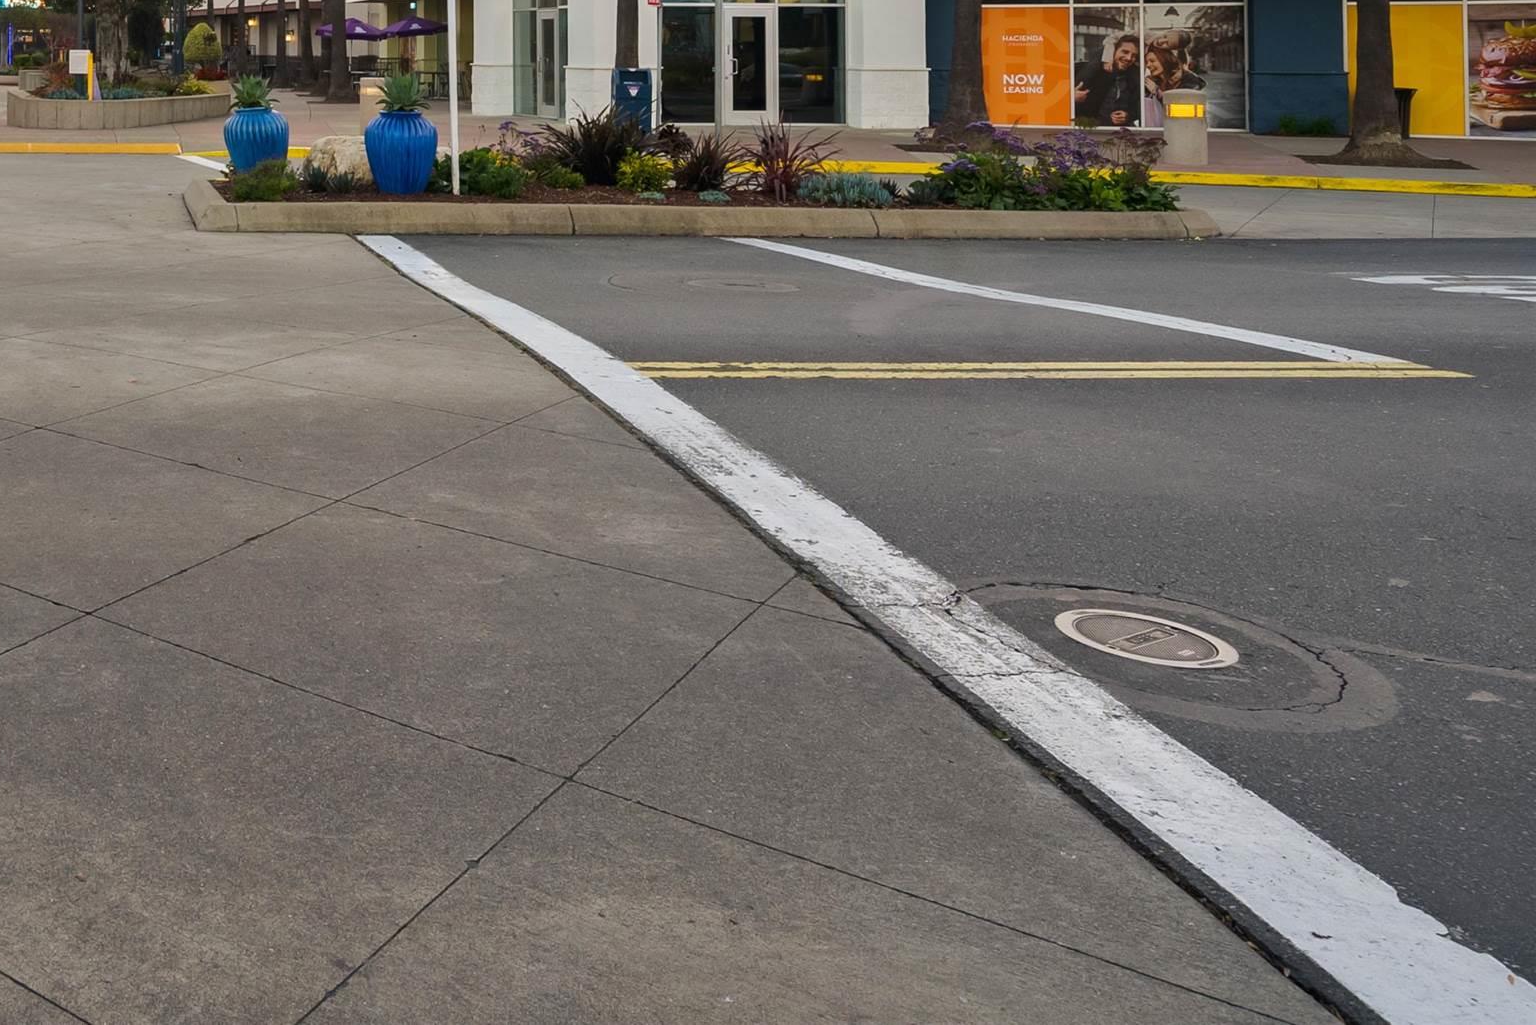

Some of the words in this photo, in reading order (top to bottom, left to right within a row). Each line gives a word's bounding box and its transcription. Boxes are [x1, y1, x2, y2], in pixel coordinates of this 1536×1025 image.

[1002, 34, 1044, 42] HACIENDA
[1003, 74, 1044, 85] NOW
[1003, 86, 1044, 94] LEASING
